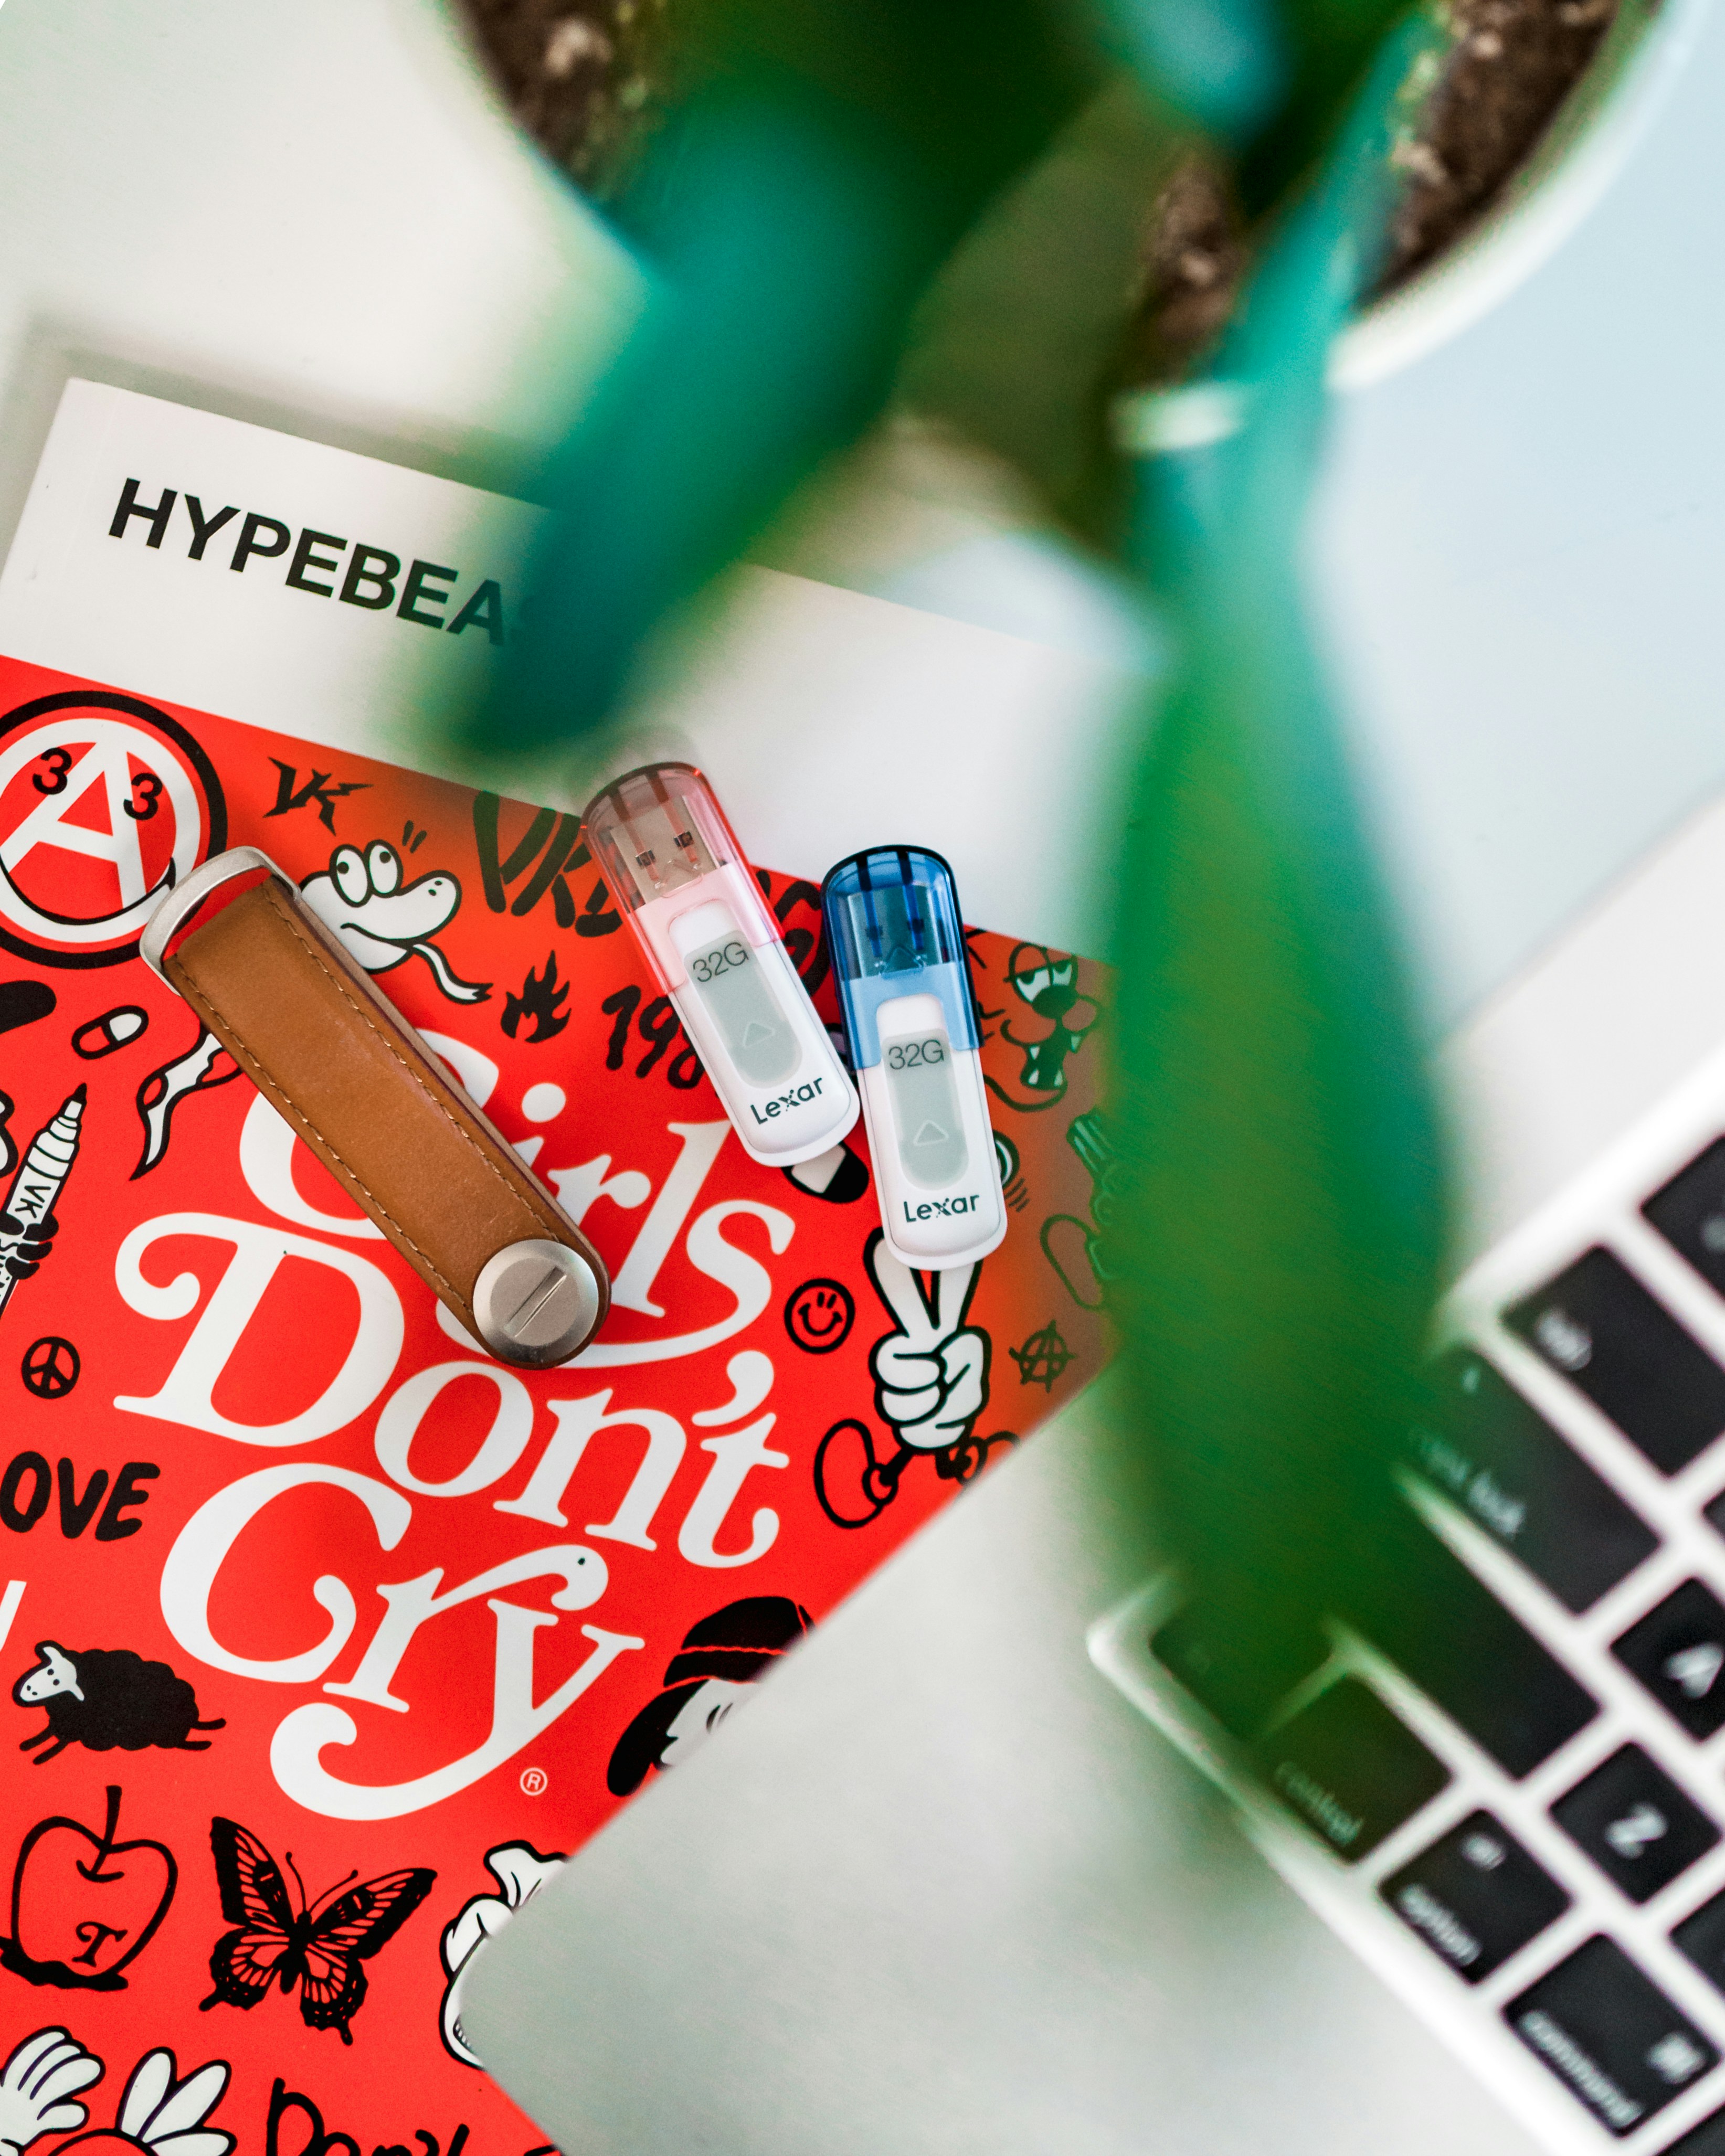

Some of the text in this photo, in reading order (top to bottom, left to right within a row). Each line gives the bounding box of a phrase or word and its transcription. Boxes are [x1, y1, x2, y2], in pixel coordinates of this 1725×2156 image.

[108, 477, 527, 645] HYPEBEA
[692, 941, 749, 983] 32G
[888, 1038, 946, 1070] 32G
[749, 1077, 824, 1125] Lexar
[903, 1194, 980, 1223] Lexar
[114, 1212, 790, 1568] Don't
[160, 1463, 645, 1821] Cry
